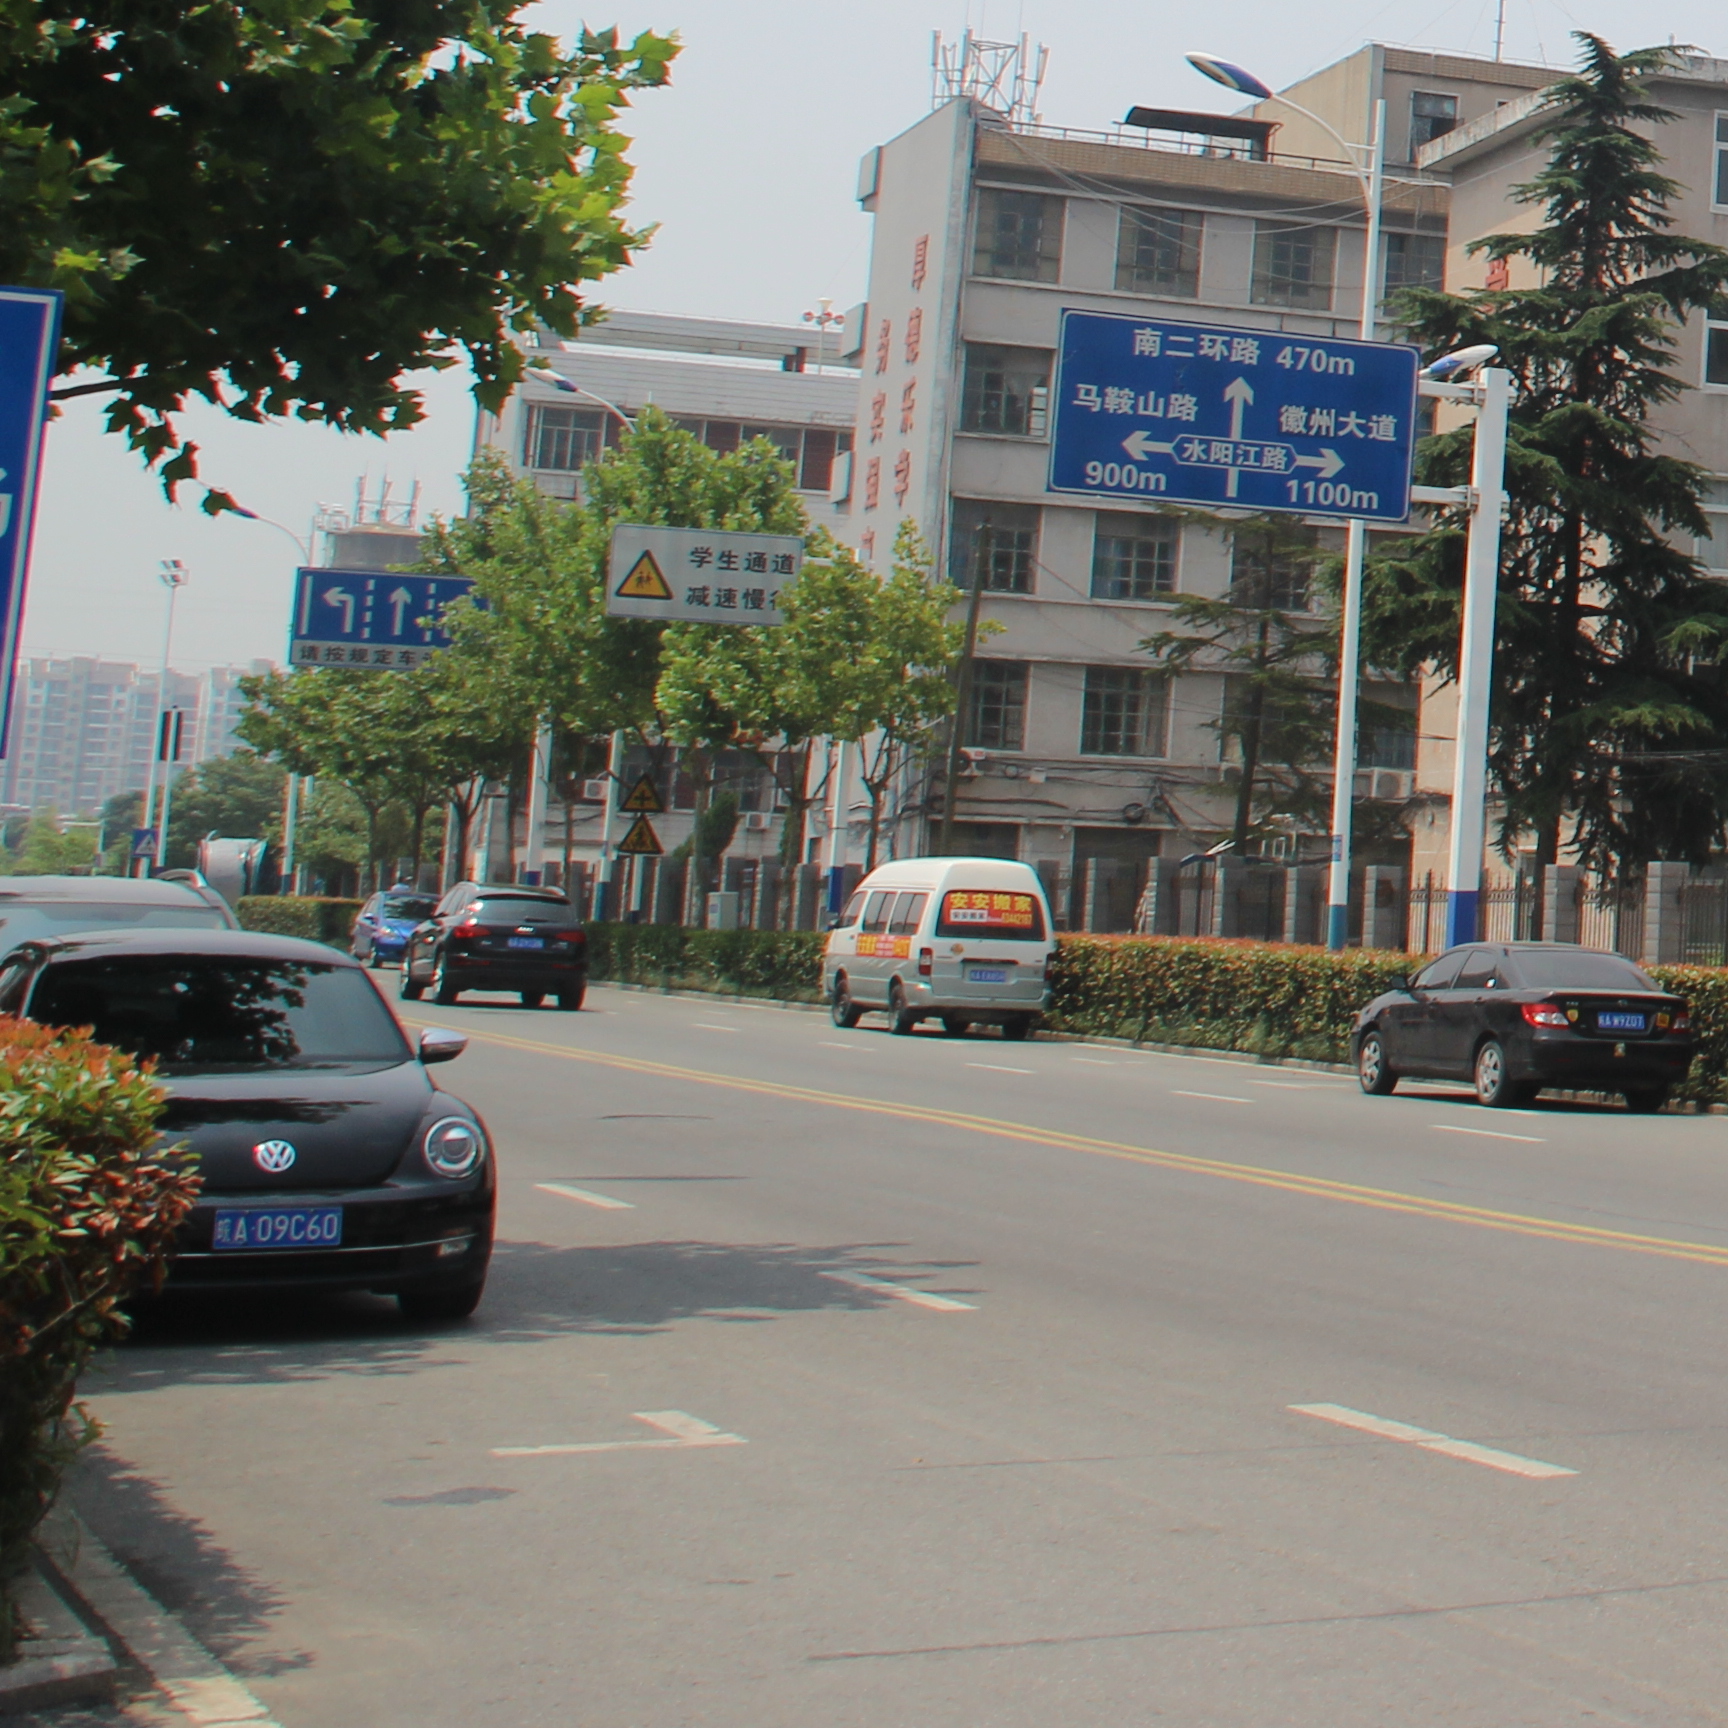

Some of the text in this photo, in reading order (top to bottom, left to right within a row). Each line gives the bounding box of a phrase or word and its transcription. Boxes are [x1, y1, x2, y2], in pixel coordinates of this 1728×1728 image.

[1133, 328, 1355, 376] 南二环路 470m
[1072, 383, 1199, 422] 马鞍山路
[1279, 404, 1397, 442] 徽州大道
[1181, 441, 1288, 472] 水阳江路
[1085, 461, 1167, 492] 900m
[1286, 479, 1379, 510] 1100m
[689, 546, 795, 574] 学生通道
